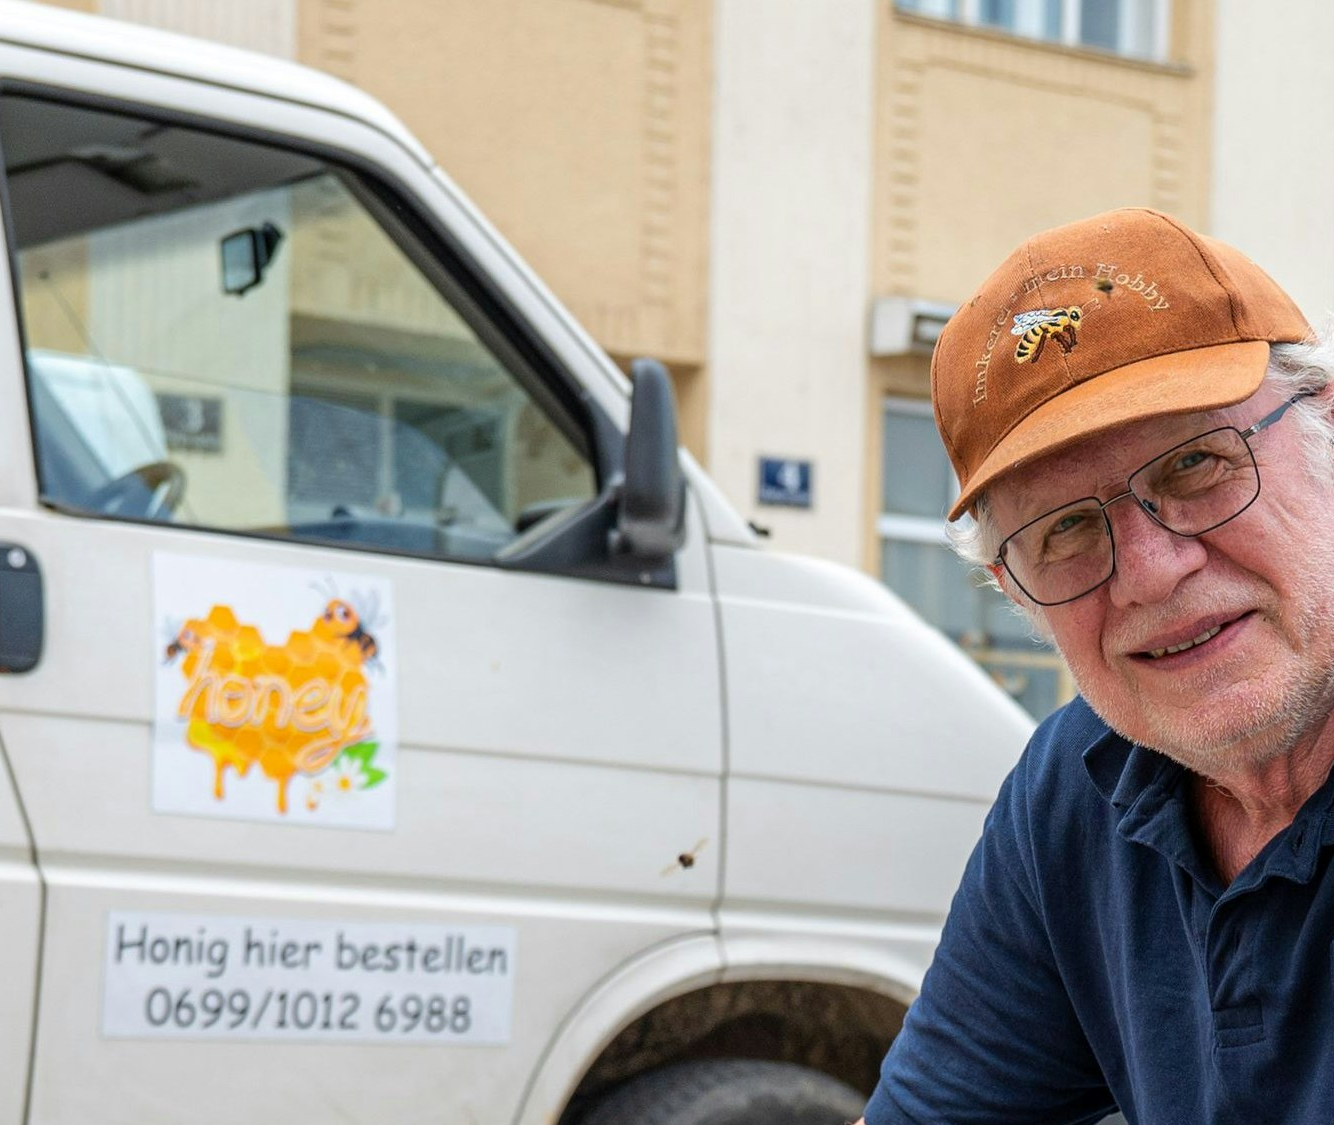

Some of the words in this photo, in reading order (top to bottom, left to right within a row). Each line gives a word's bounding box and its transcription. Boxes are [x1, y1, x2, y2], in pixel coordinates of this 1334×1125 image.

[1023, 263, 1086, 295] mein
[1092, 262, 1171, 313] Hobby
[177, 636, 375, 777] honey
[114, 924, 230, 979] Honig
[242, 926, 324, 971] hier
[335, 930, 509, 976] bestellen
[144, 986, 361, 1031] 0699/1012
[373, 992, 473, 1035] 6988
